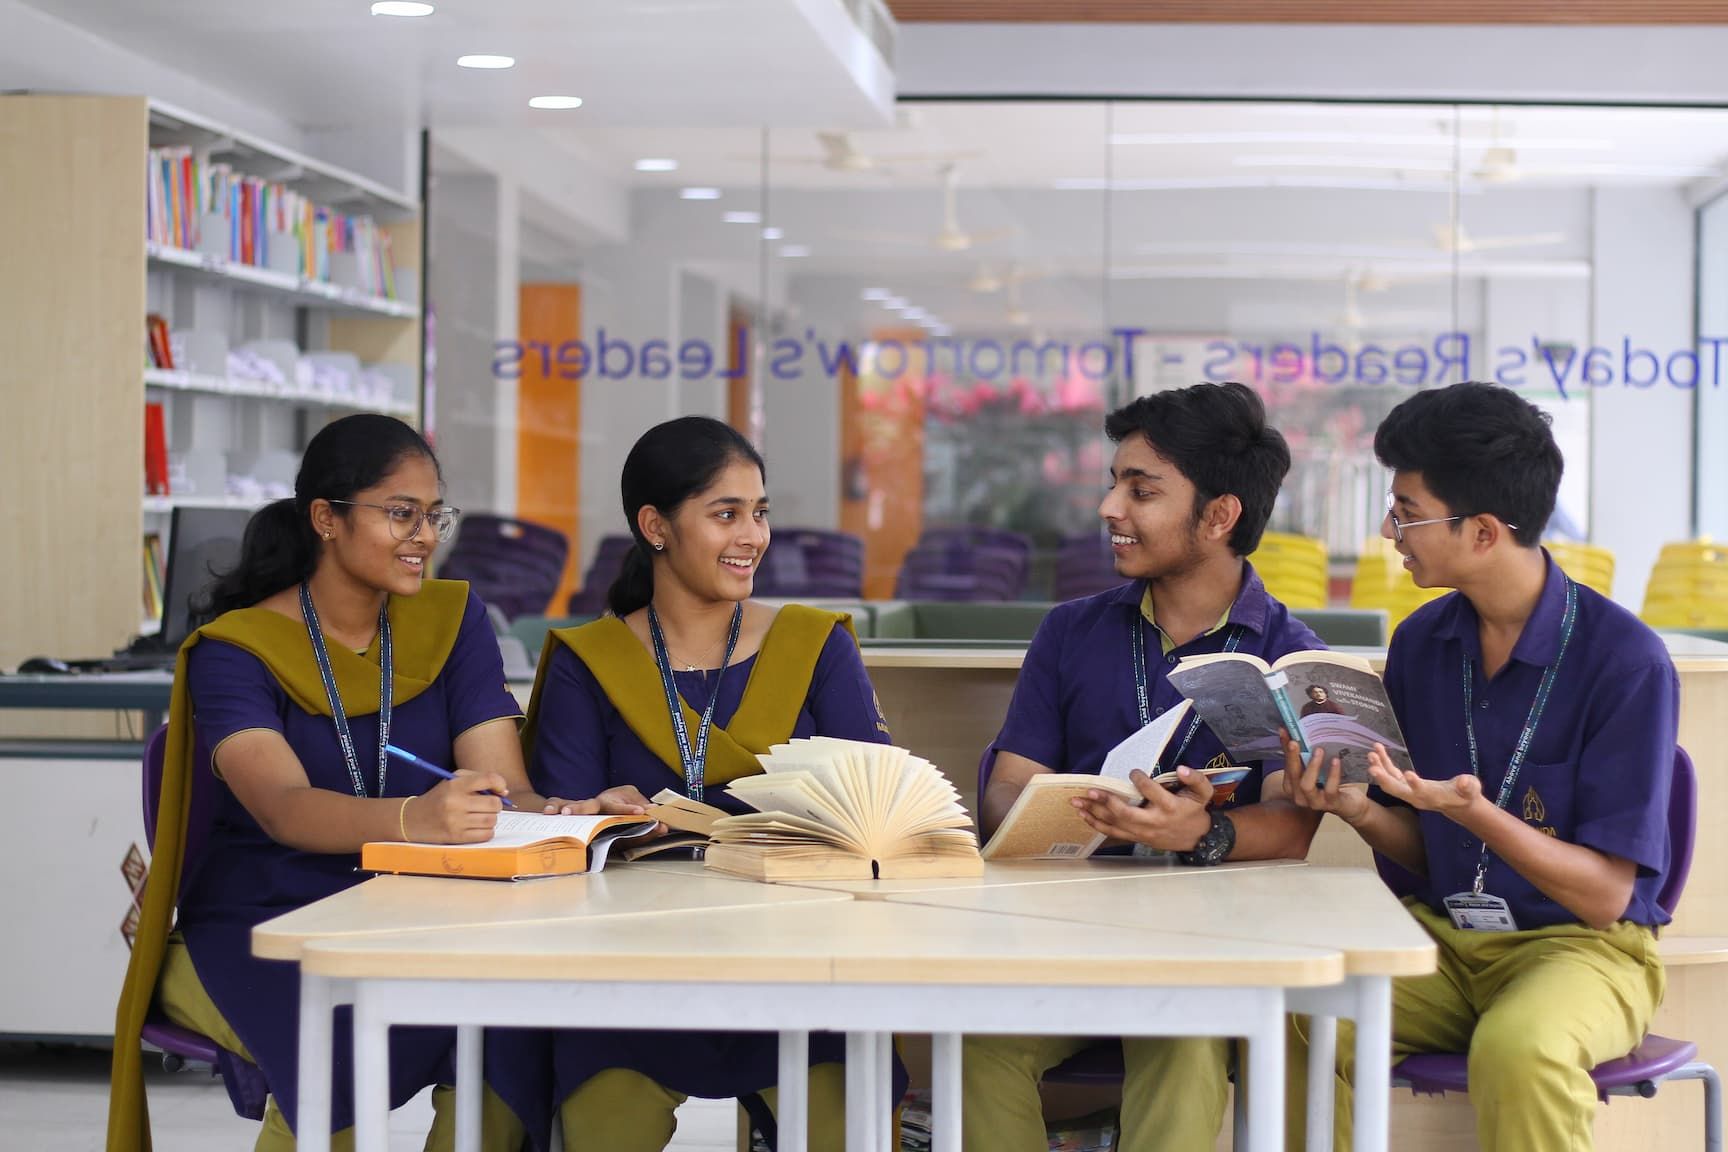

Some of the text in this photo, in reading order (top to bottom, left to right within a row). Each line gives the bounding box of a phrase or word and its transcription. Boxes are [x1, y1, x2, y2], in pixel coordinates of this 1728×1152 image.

[1137, 685, 1147, 707] beyond
[673, 711, 686, 732] beyond
[341, 733, 361, 791] Above and beyond
[1504, 726, 1532, 784] Above and beyond
